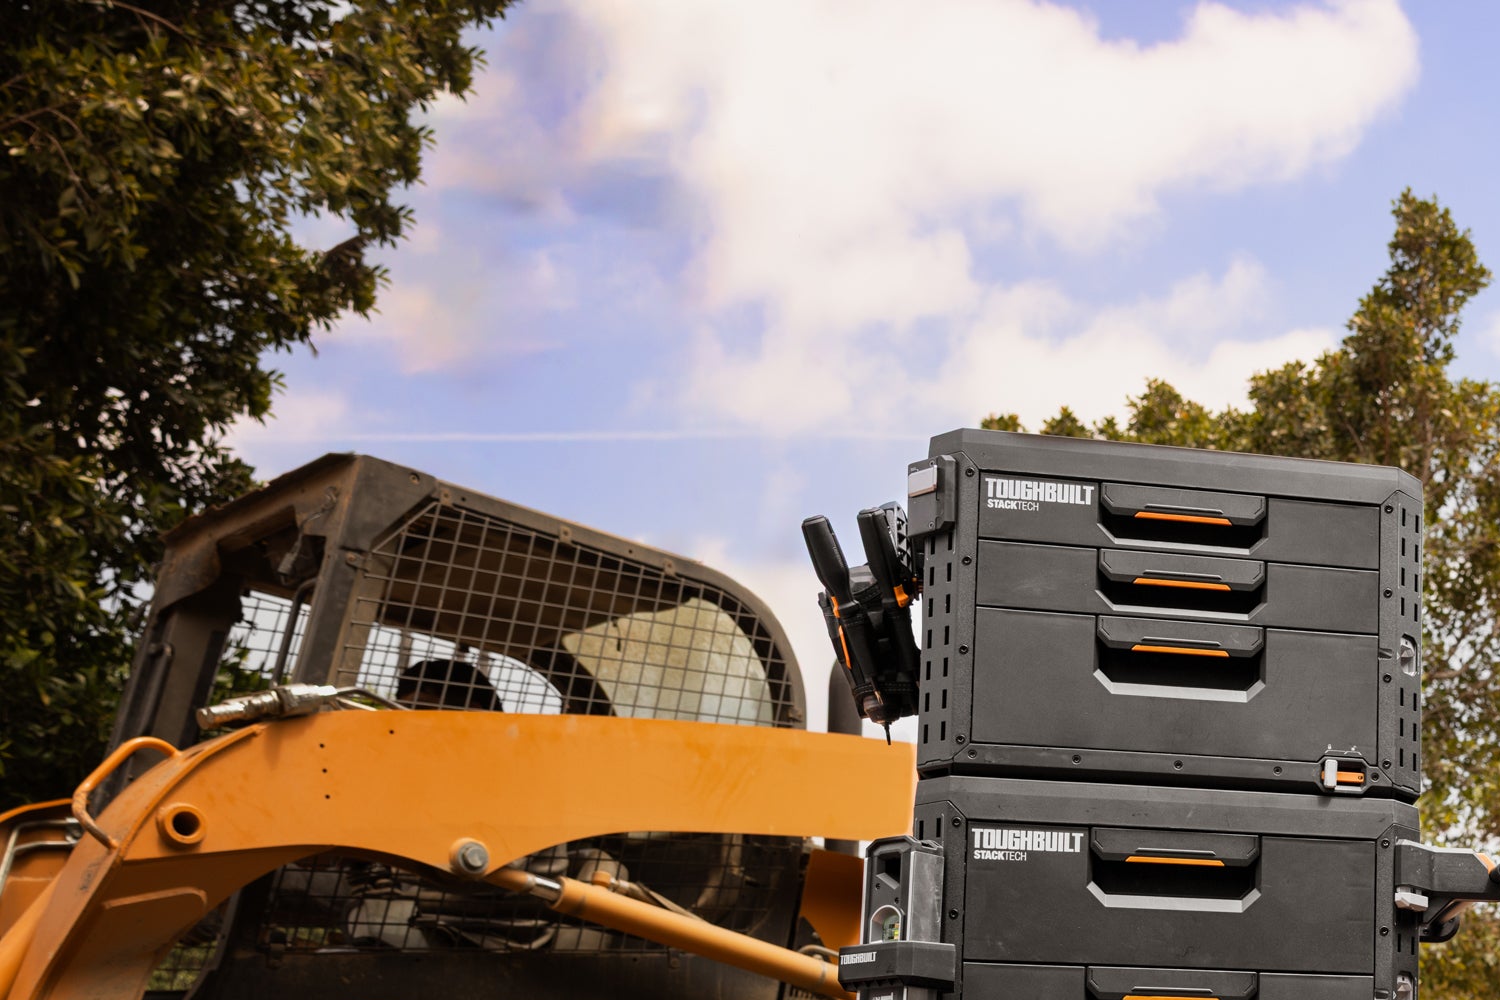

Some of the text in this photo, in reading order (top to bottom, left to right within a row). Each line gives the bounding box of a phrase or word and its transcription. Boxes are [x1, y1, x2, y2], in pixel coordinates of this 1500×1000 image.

[985, 478, 1094, 505] TOUGHBUILT
[987, 499, 1039, 511] STACKTECH
[971, 828, 1084, 853] TOUGHBUILT
[973, 849, 1027, 861] STACKTECH
[840, 951, 877, 965] TOUGHBUILT
